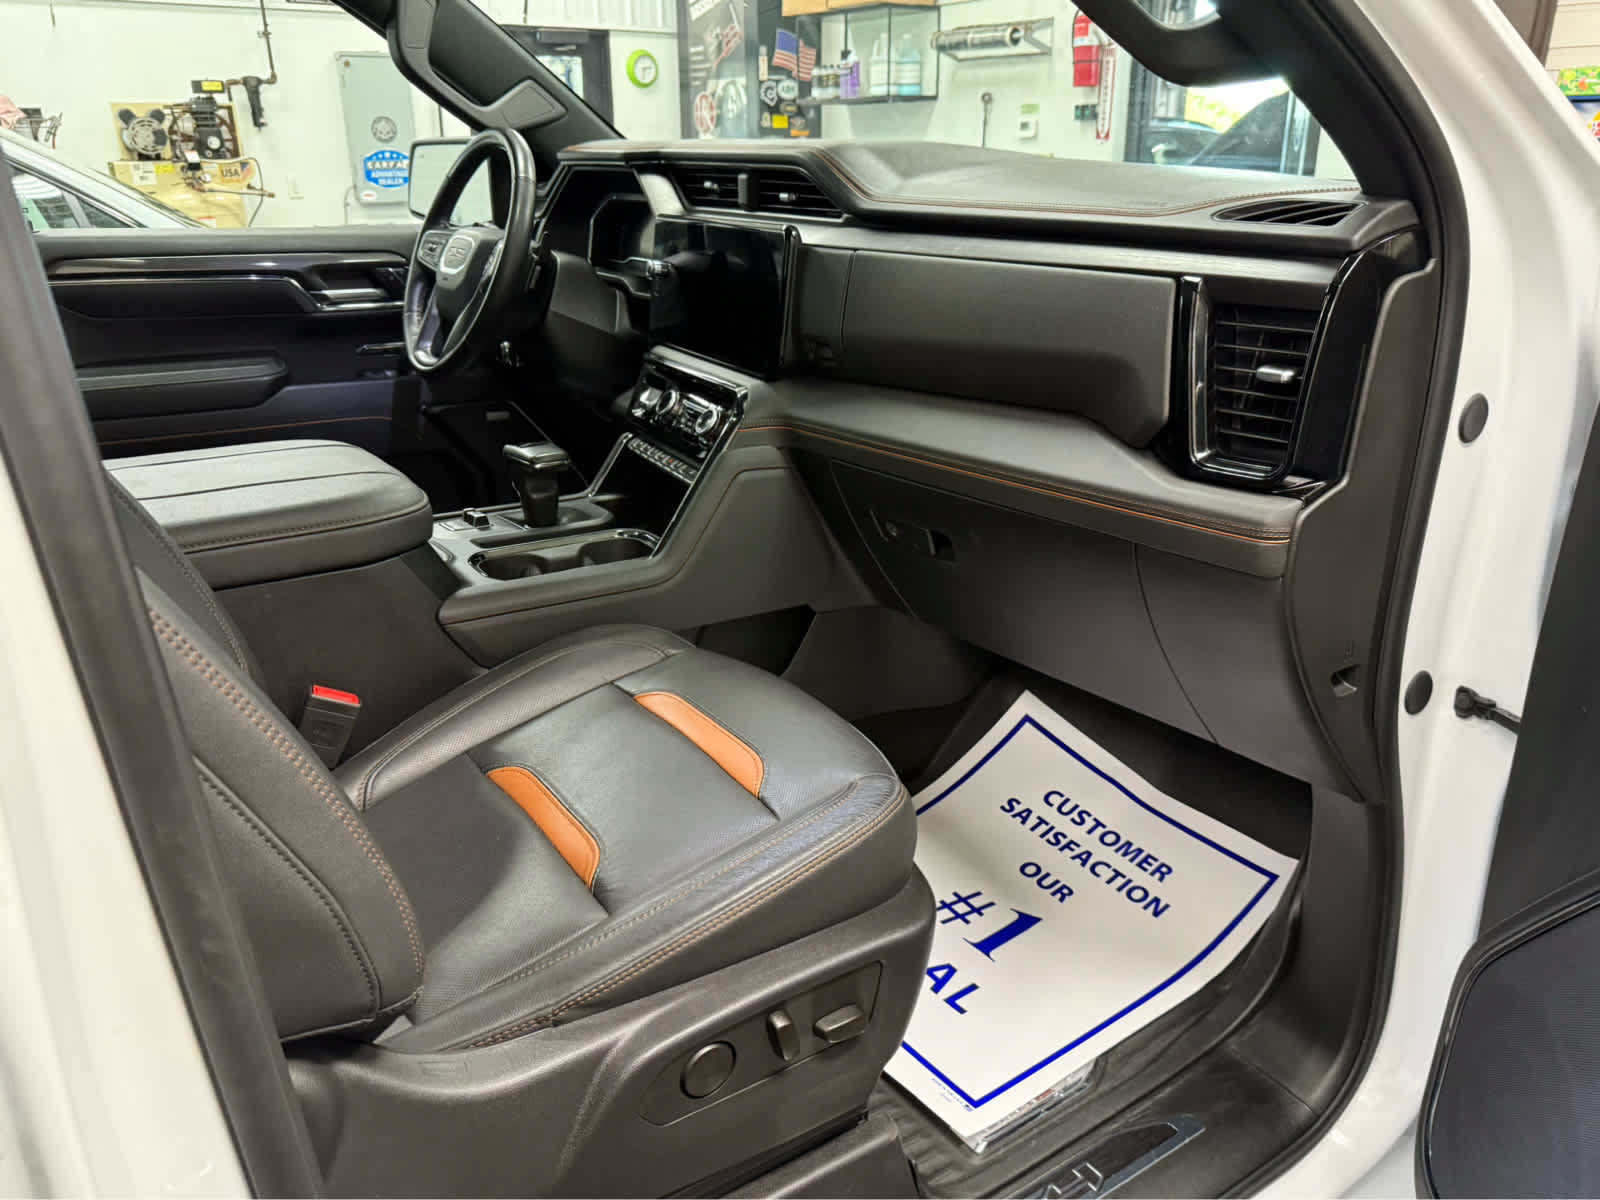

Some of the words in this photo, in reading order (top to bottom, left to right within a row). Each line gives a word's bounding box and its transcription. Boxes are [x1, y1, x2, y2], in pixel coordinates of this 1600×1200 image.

[222, 166, 241, 178] USA
[999, 797, 1171, 918] SATISFACTION
[1042, 790, 1174, 883] CUSTOMER
[1019, 861, 1075, 903] OUR
[935, 891, 1043, 962] #1
[925, 963, 980, 1015] AL
